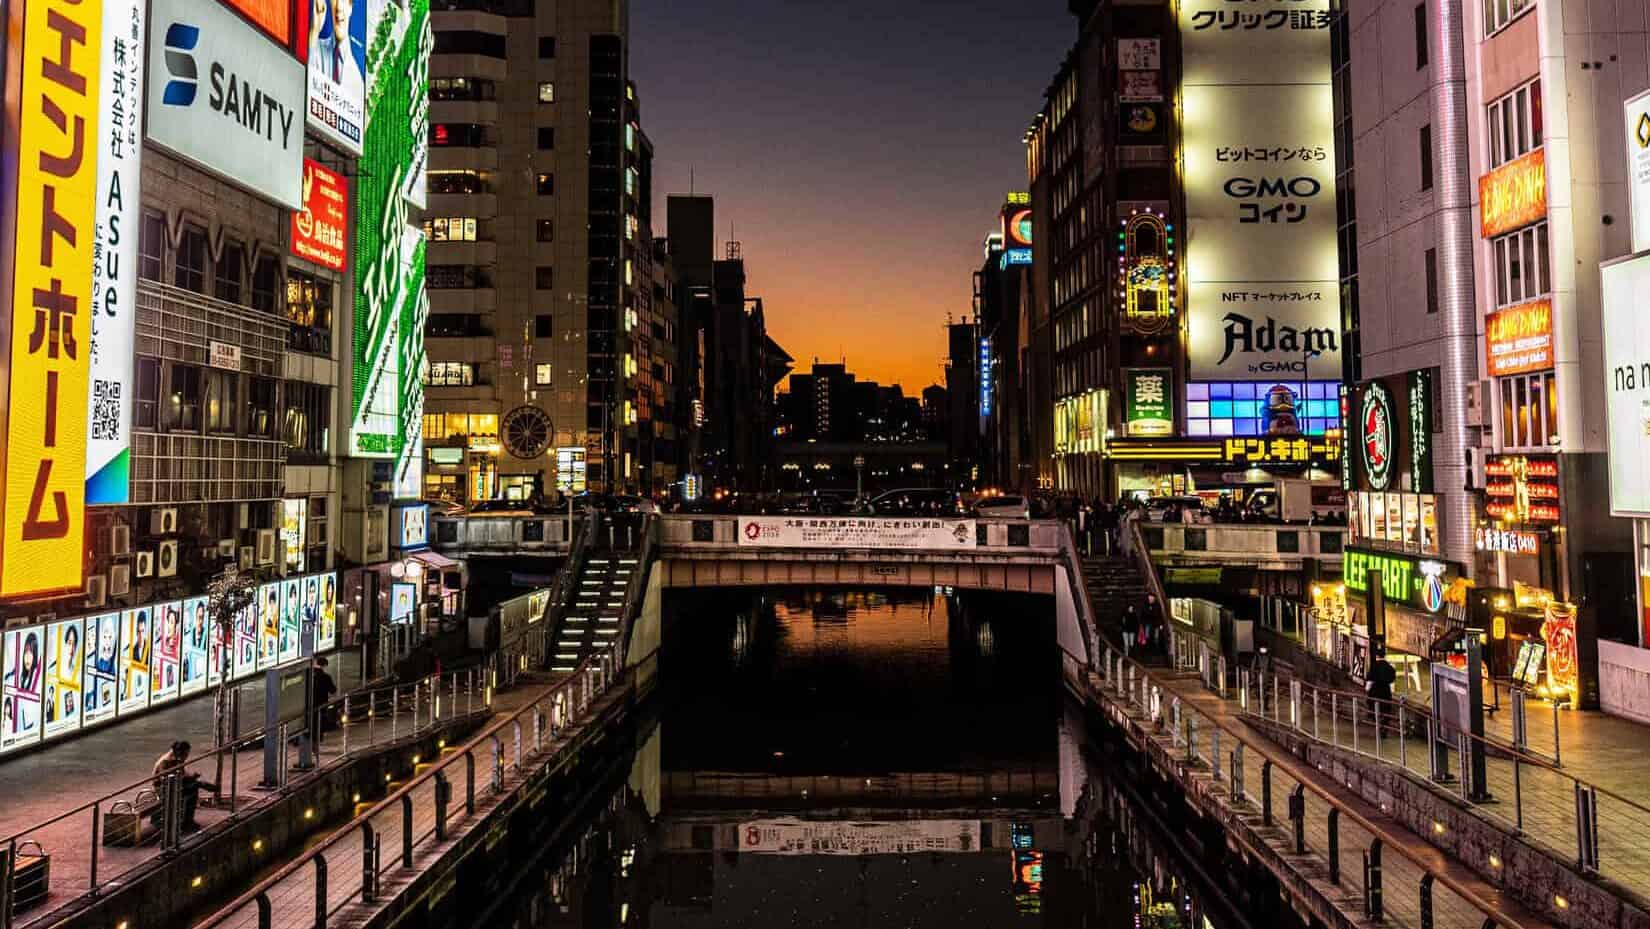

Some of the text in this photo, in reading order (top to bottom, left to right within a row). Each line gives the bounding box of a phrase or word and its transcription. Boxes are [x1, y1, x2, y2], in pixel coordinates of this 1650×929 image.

[208, 61, 294, 150] SAMTY
[1216, 147, 1327, 162] ビットコインなら
[104, 36, 128, 318] 株式会社 Asue
[1224, 177, 1321, 198] GMO
[1484, 162, 1545, 224] LONG DINH
[1239, 203, 1306, 224] コイン
[1222, 292, 1321, 302] NFT マーケットプレイス
[1490, 304, 1548, 342] LONG DINH
[1217, 312, 1338, 366] Adam
[1248, 361, 1306, 374] by GMO
[1615, 361, 1636, 392] na
[1136, 376, 1164, 403] 薬
